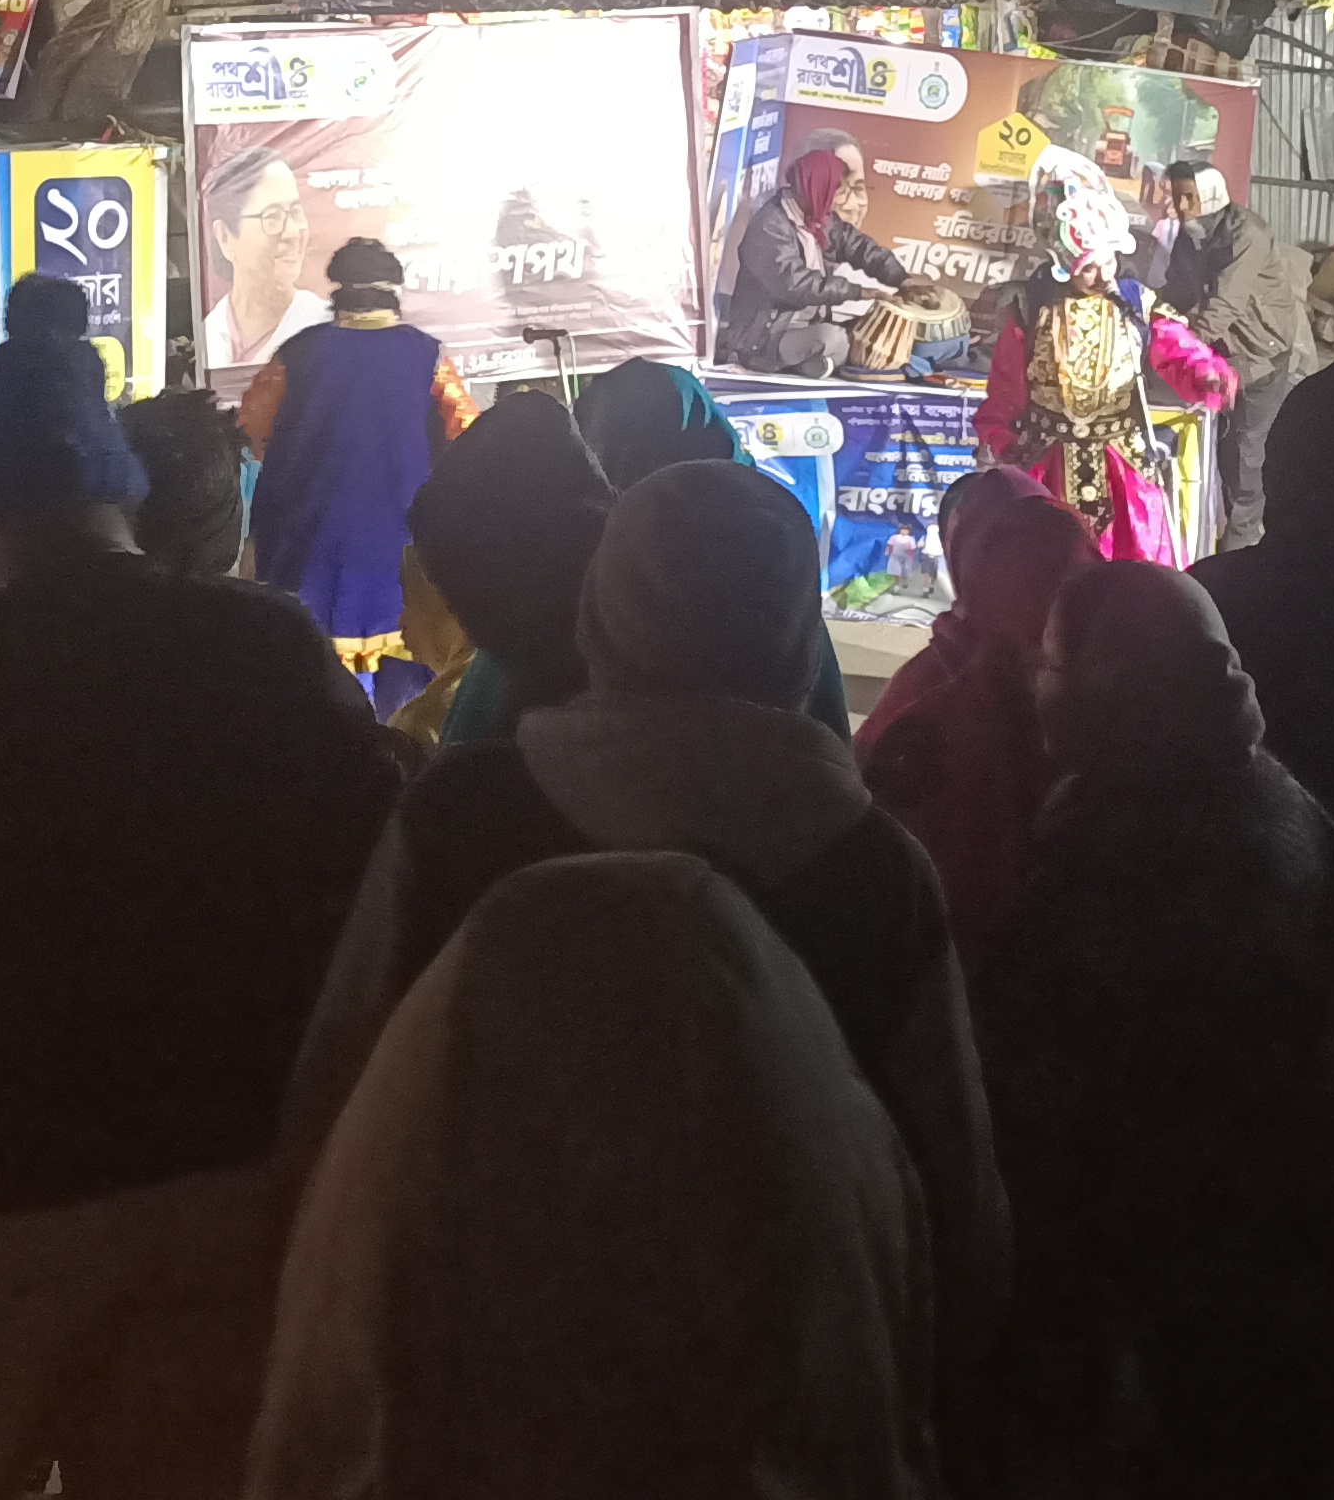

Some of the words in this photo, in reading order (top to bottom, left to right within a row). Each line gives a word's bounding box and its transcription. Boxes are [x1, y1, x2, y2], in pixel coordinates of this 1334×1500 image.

[998, 119, 1032, 150] ২০
[873, 158, 921, 179] বাংলার
[921, 162, 952, 182] মাটি
[893, 179, 948, 201] বাংলার
[40, 188, 129, 267] ২০
[489, 239, 592, 285] শপথ
[891, 236, 1019, 286] বাংলার
[838, 485, 948, 517] বাংলার
